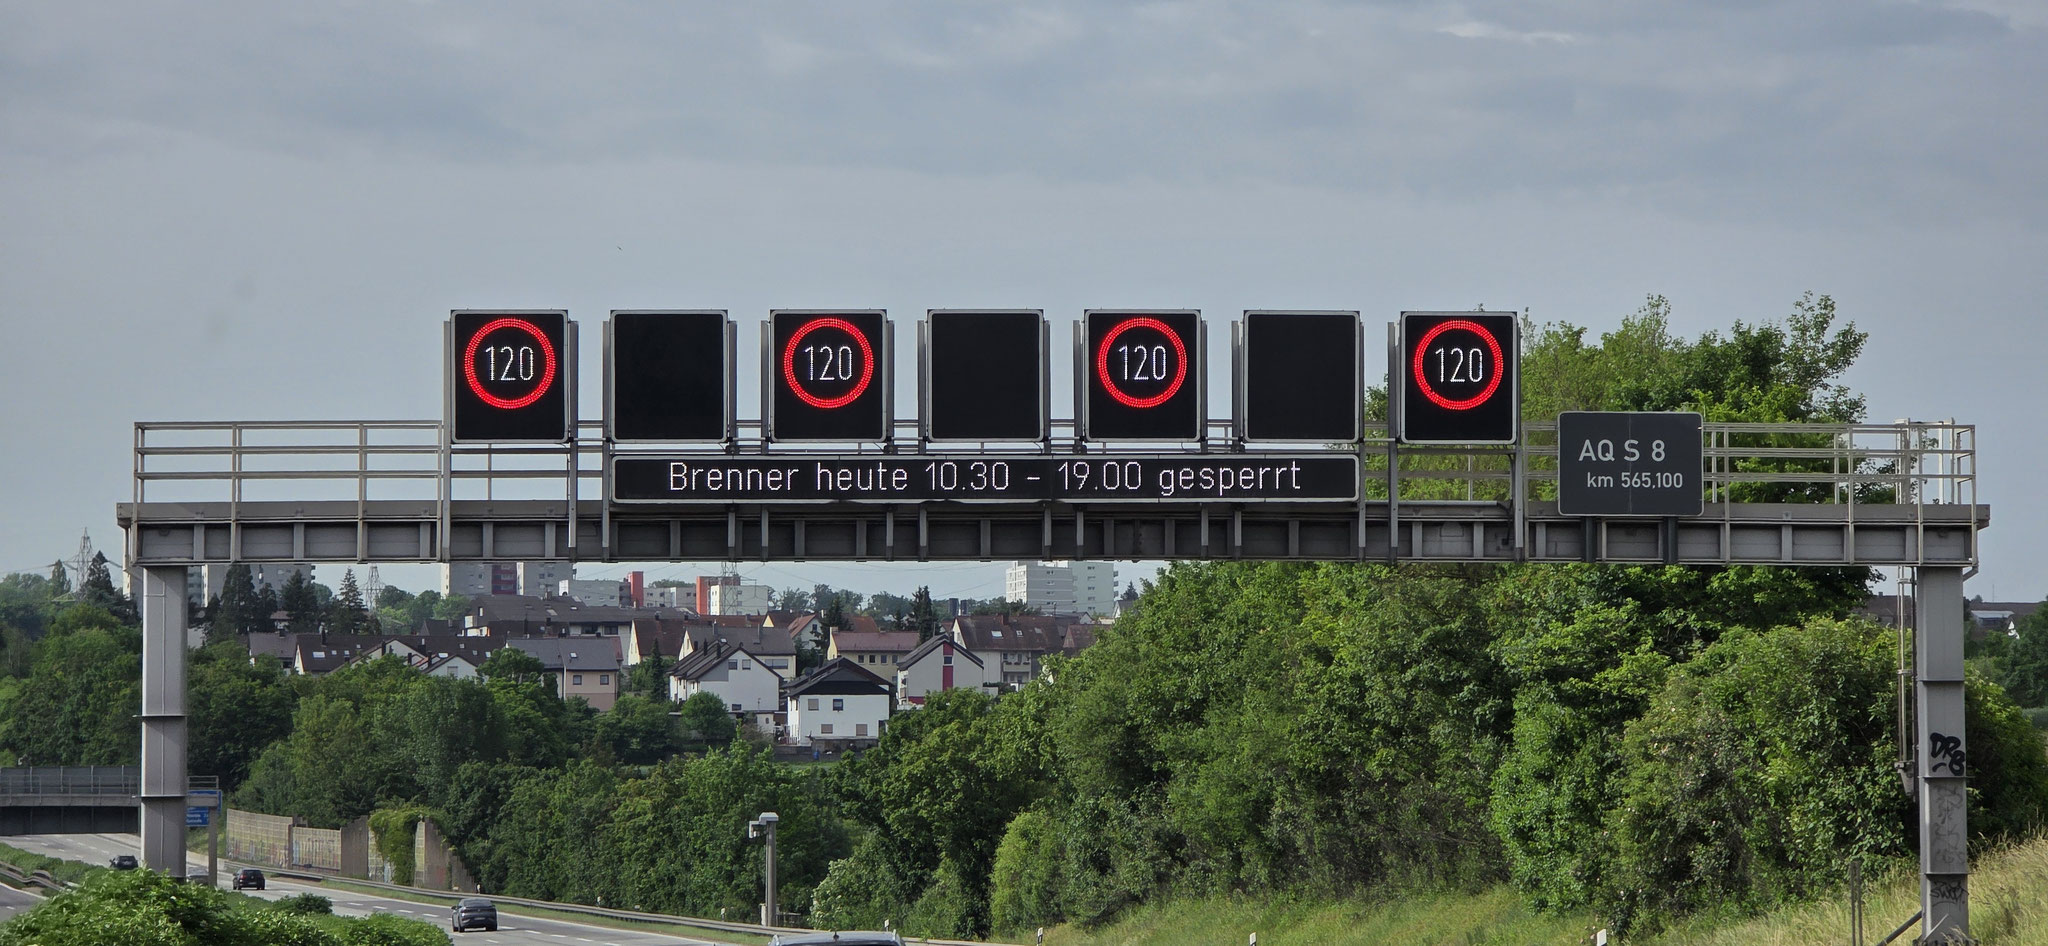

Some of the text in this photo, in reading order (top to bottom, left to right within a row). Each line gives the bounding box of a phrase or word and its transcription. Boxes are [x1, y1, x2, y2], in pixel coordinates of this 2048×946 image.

[485, 346, 534, 380] 120
[804, 346, 853, 380] 120
[1118, 345, 1167, 380] 120
[1435, 348, 1483, 382] 120
[1578, 439, 1666, 462] AQ S 8
[670, 462, 800, 491] Brenner
[817, 462, 908, 491] heute
[925, 461, 1009, 490] 10.30
[1058, 461, 1142, 490] 19.00
[1159, 461, 1301, 496] gesperrt
[1587, 471, 1683, 491] km 565,100
